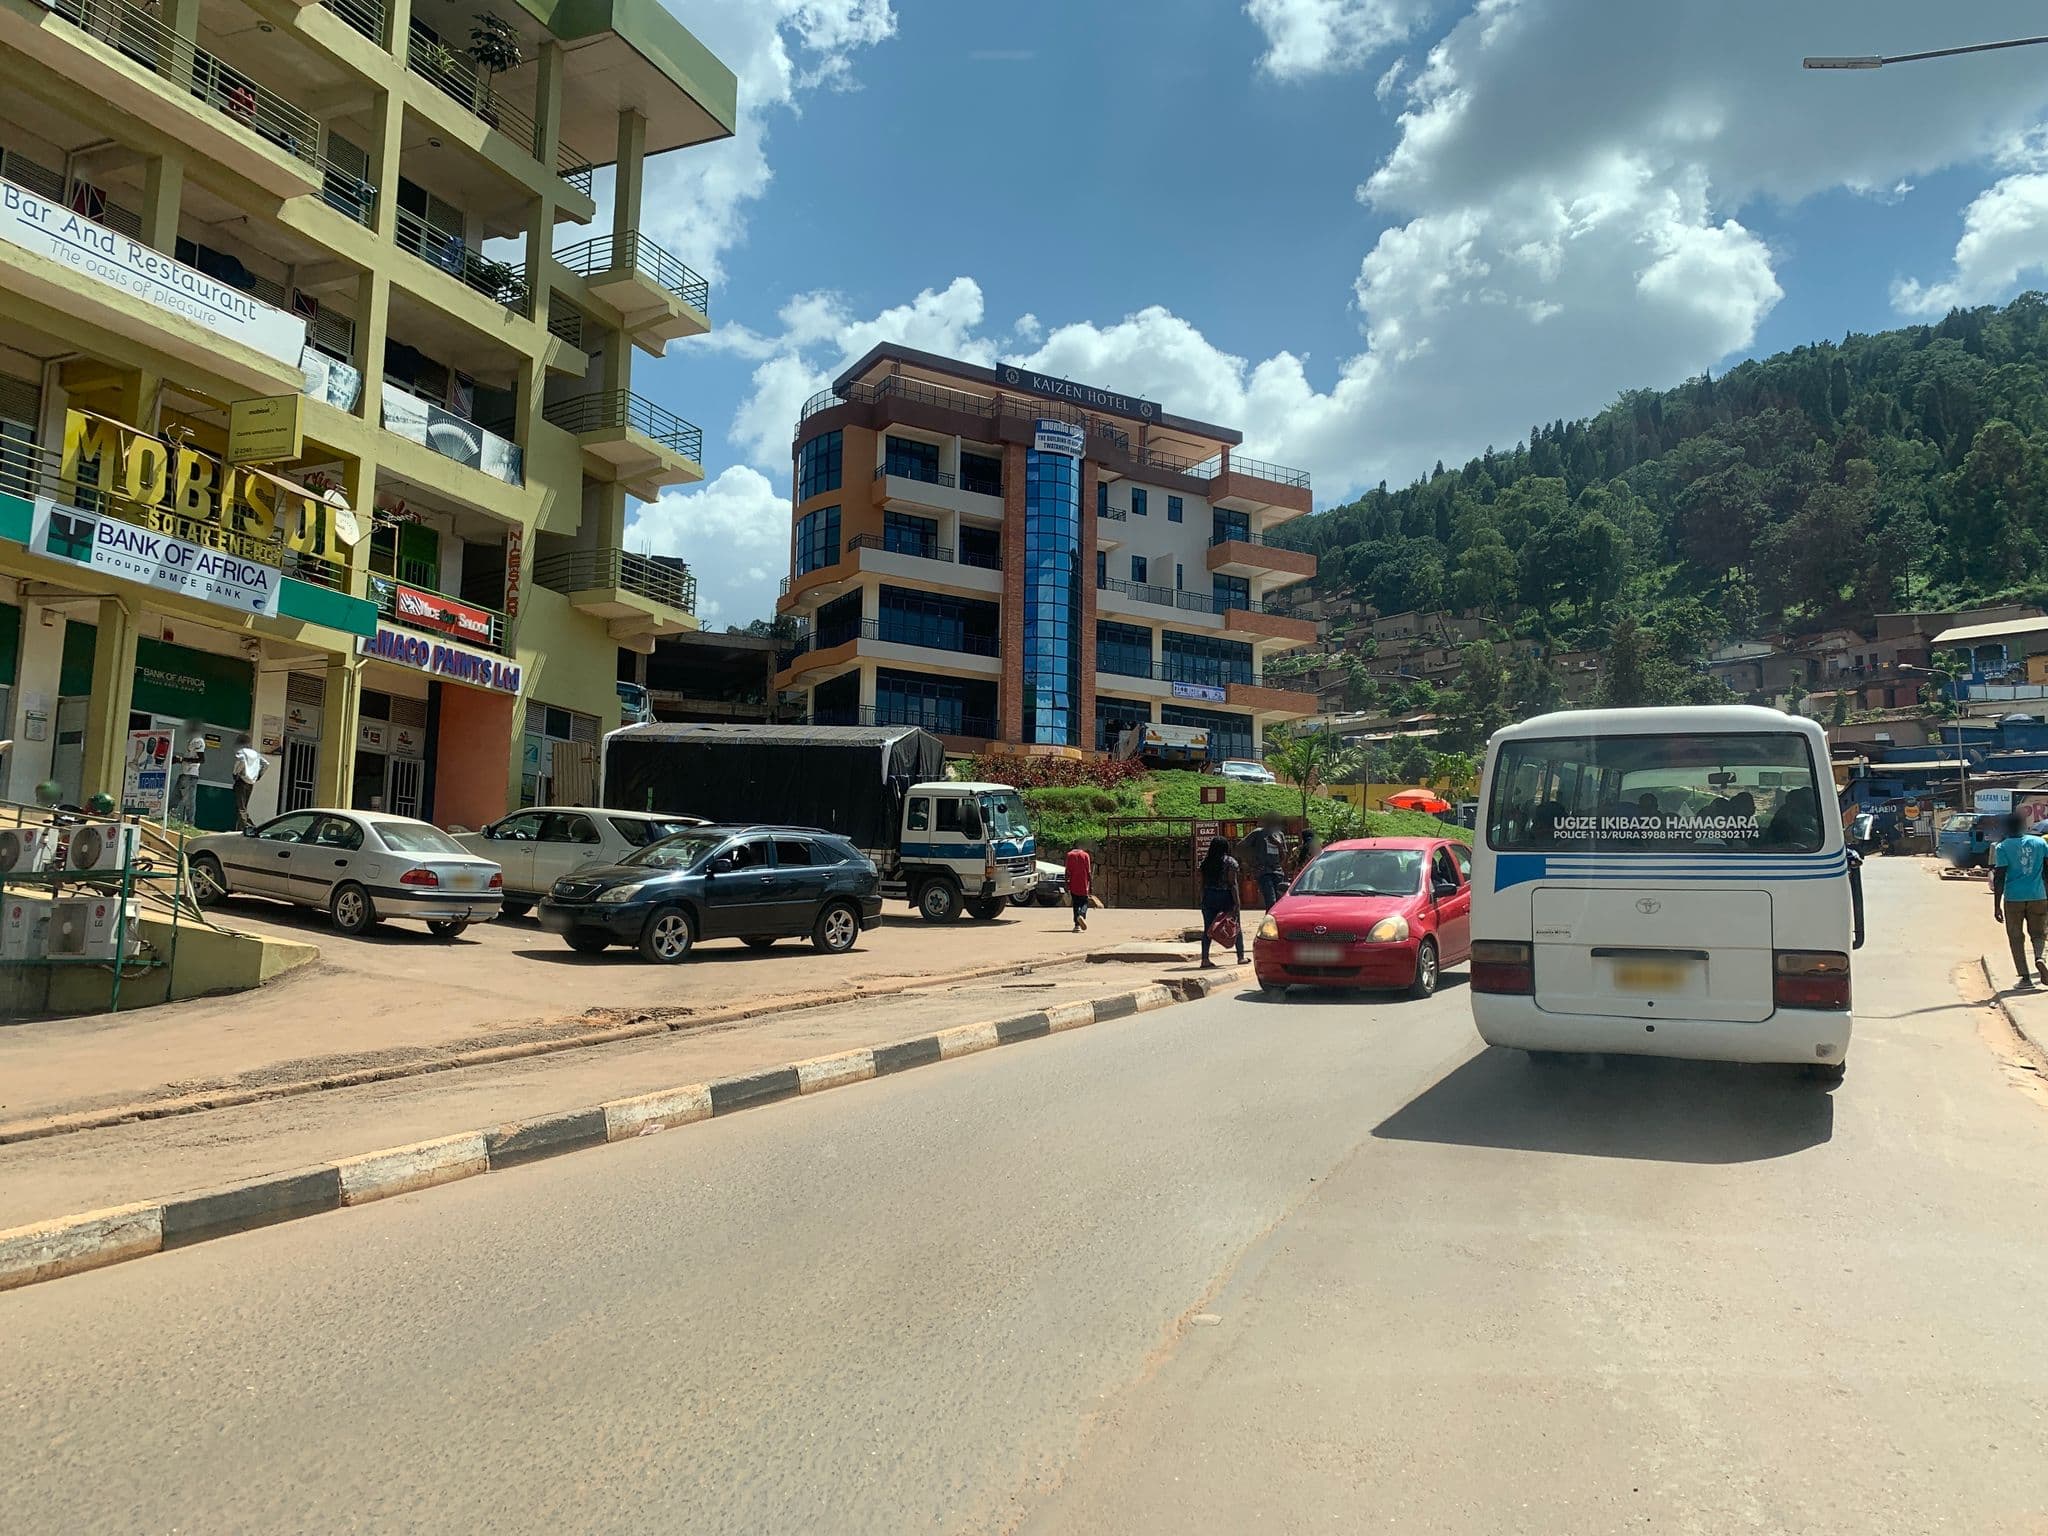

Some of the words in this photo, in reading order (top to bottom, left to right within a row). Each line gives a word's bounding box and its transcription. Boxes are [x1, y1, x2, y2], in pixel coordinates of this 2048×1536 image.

[3, 183, 51, 223] Bar
[60, 215, 116, 256] And
[127, 242, 257, 320] Restaurant
[50, 238, 81, 265] The
[86, 260, 127, 285] oasis
[132, 280, 152, 298] of
[154, 290, 216, 325] pleasure
[1033, 375, 1082, 399] KAIZEN
[1087, 390, 1129, 411] HOTEL
[61, 408, 346, 566] MOBISOL
[147, 506, 211, 547] SOLAR
[96, 552, 150, 575] Groupe
[159, 570, 197, 588] BMCE
[206, 583, 241, 599] BANK
[98, 522, 160, 560] BANK
[165, 543, 195, 567] OF
[196, 553, 268, 590] AFRICA
[143, 667, 165, 679] BANK
[165, 672, 177, 681] OF
[177, 675, 206, 688] AFRICA
[432, 645, 492, 684] PAINTS
[493, 662, 520, 692] Ltd
[1553, 816, 1597, 830] UGIZE
[1601, 816, 1662, 830] IKIBAZO
[1666, 815, 1759, 830] HAMAGARA
[1641, 830, 1666, 840] 3988
[1667, 830, 1693, 840] RFTC
[1695, 830, 1760, 840] 0788302174
[105, 841, 114, 849] LG
